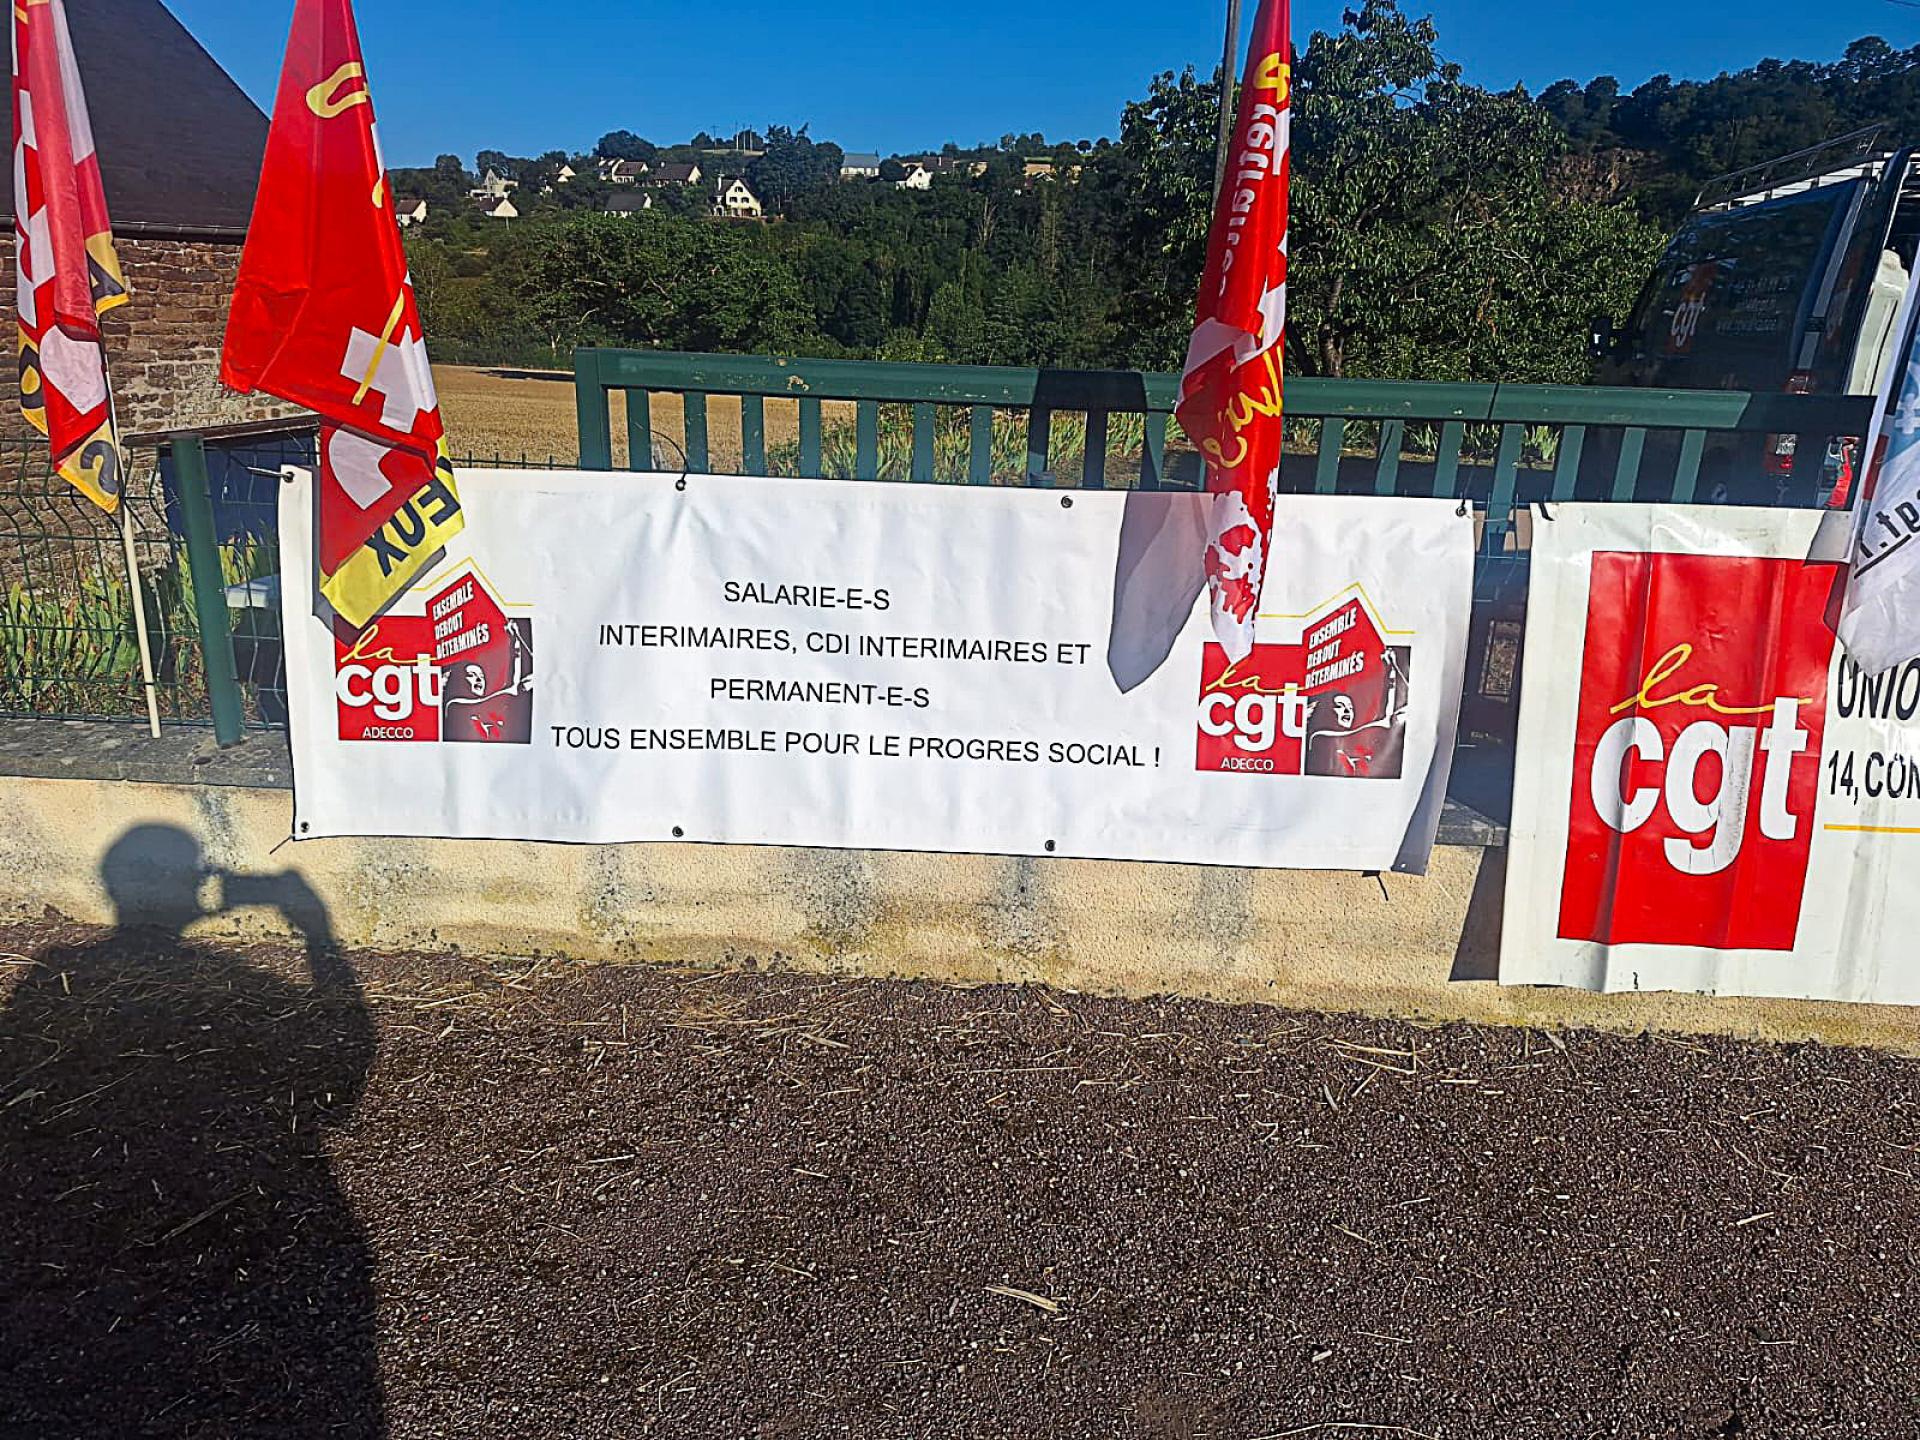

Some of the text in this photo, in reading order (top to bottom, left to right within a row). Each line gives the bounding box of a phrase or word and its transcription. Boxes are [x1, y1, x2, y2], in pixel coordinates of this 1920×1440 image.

[432, 581, 475, 620] ENSEMBLE
[725, 582, 889, 610] SALARIE-E-S
[340, 624, 438, 664] la
[434, 611, 463, 640] DEBOUT
[435, 622, 490, 660] DÉTERMINÉS
[600, 625, 1091, 664] INTERIMAIRES, CDI INTERIMAIRES ET
[1308, 607, 1358, 649] ENSEMBLE
[1305, 651, 1364, 690] DÉTERMINÉS
[1307, 639, 1342, 669] DEBOUT
[336, 653, 442, 720] cgt
[712, 679, 929, 708] PERMANENT-E-S
[1206, 663, 1305, 693] la
[1610, 643, 1812, 715] la
[362, 726, 414, 739] ADECCO
[1199, 683, 1308, 751] cgt
[551, 726, 619, 749] TOUS
[631, 730, 775, 751] ENSEMBLE
[786, 732, 859, 754] POUR
[870, 736, 899, 756] LE
[910, 737, 1038, 762] PROGRES
[1049, 743, 1144, 766] SOCIAL
[1220, 757, 1274, 771] ADECCO
[1590, 697, 1808, 876] cgt
